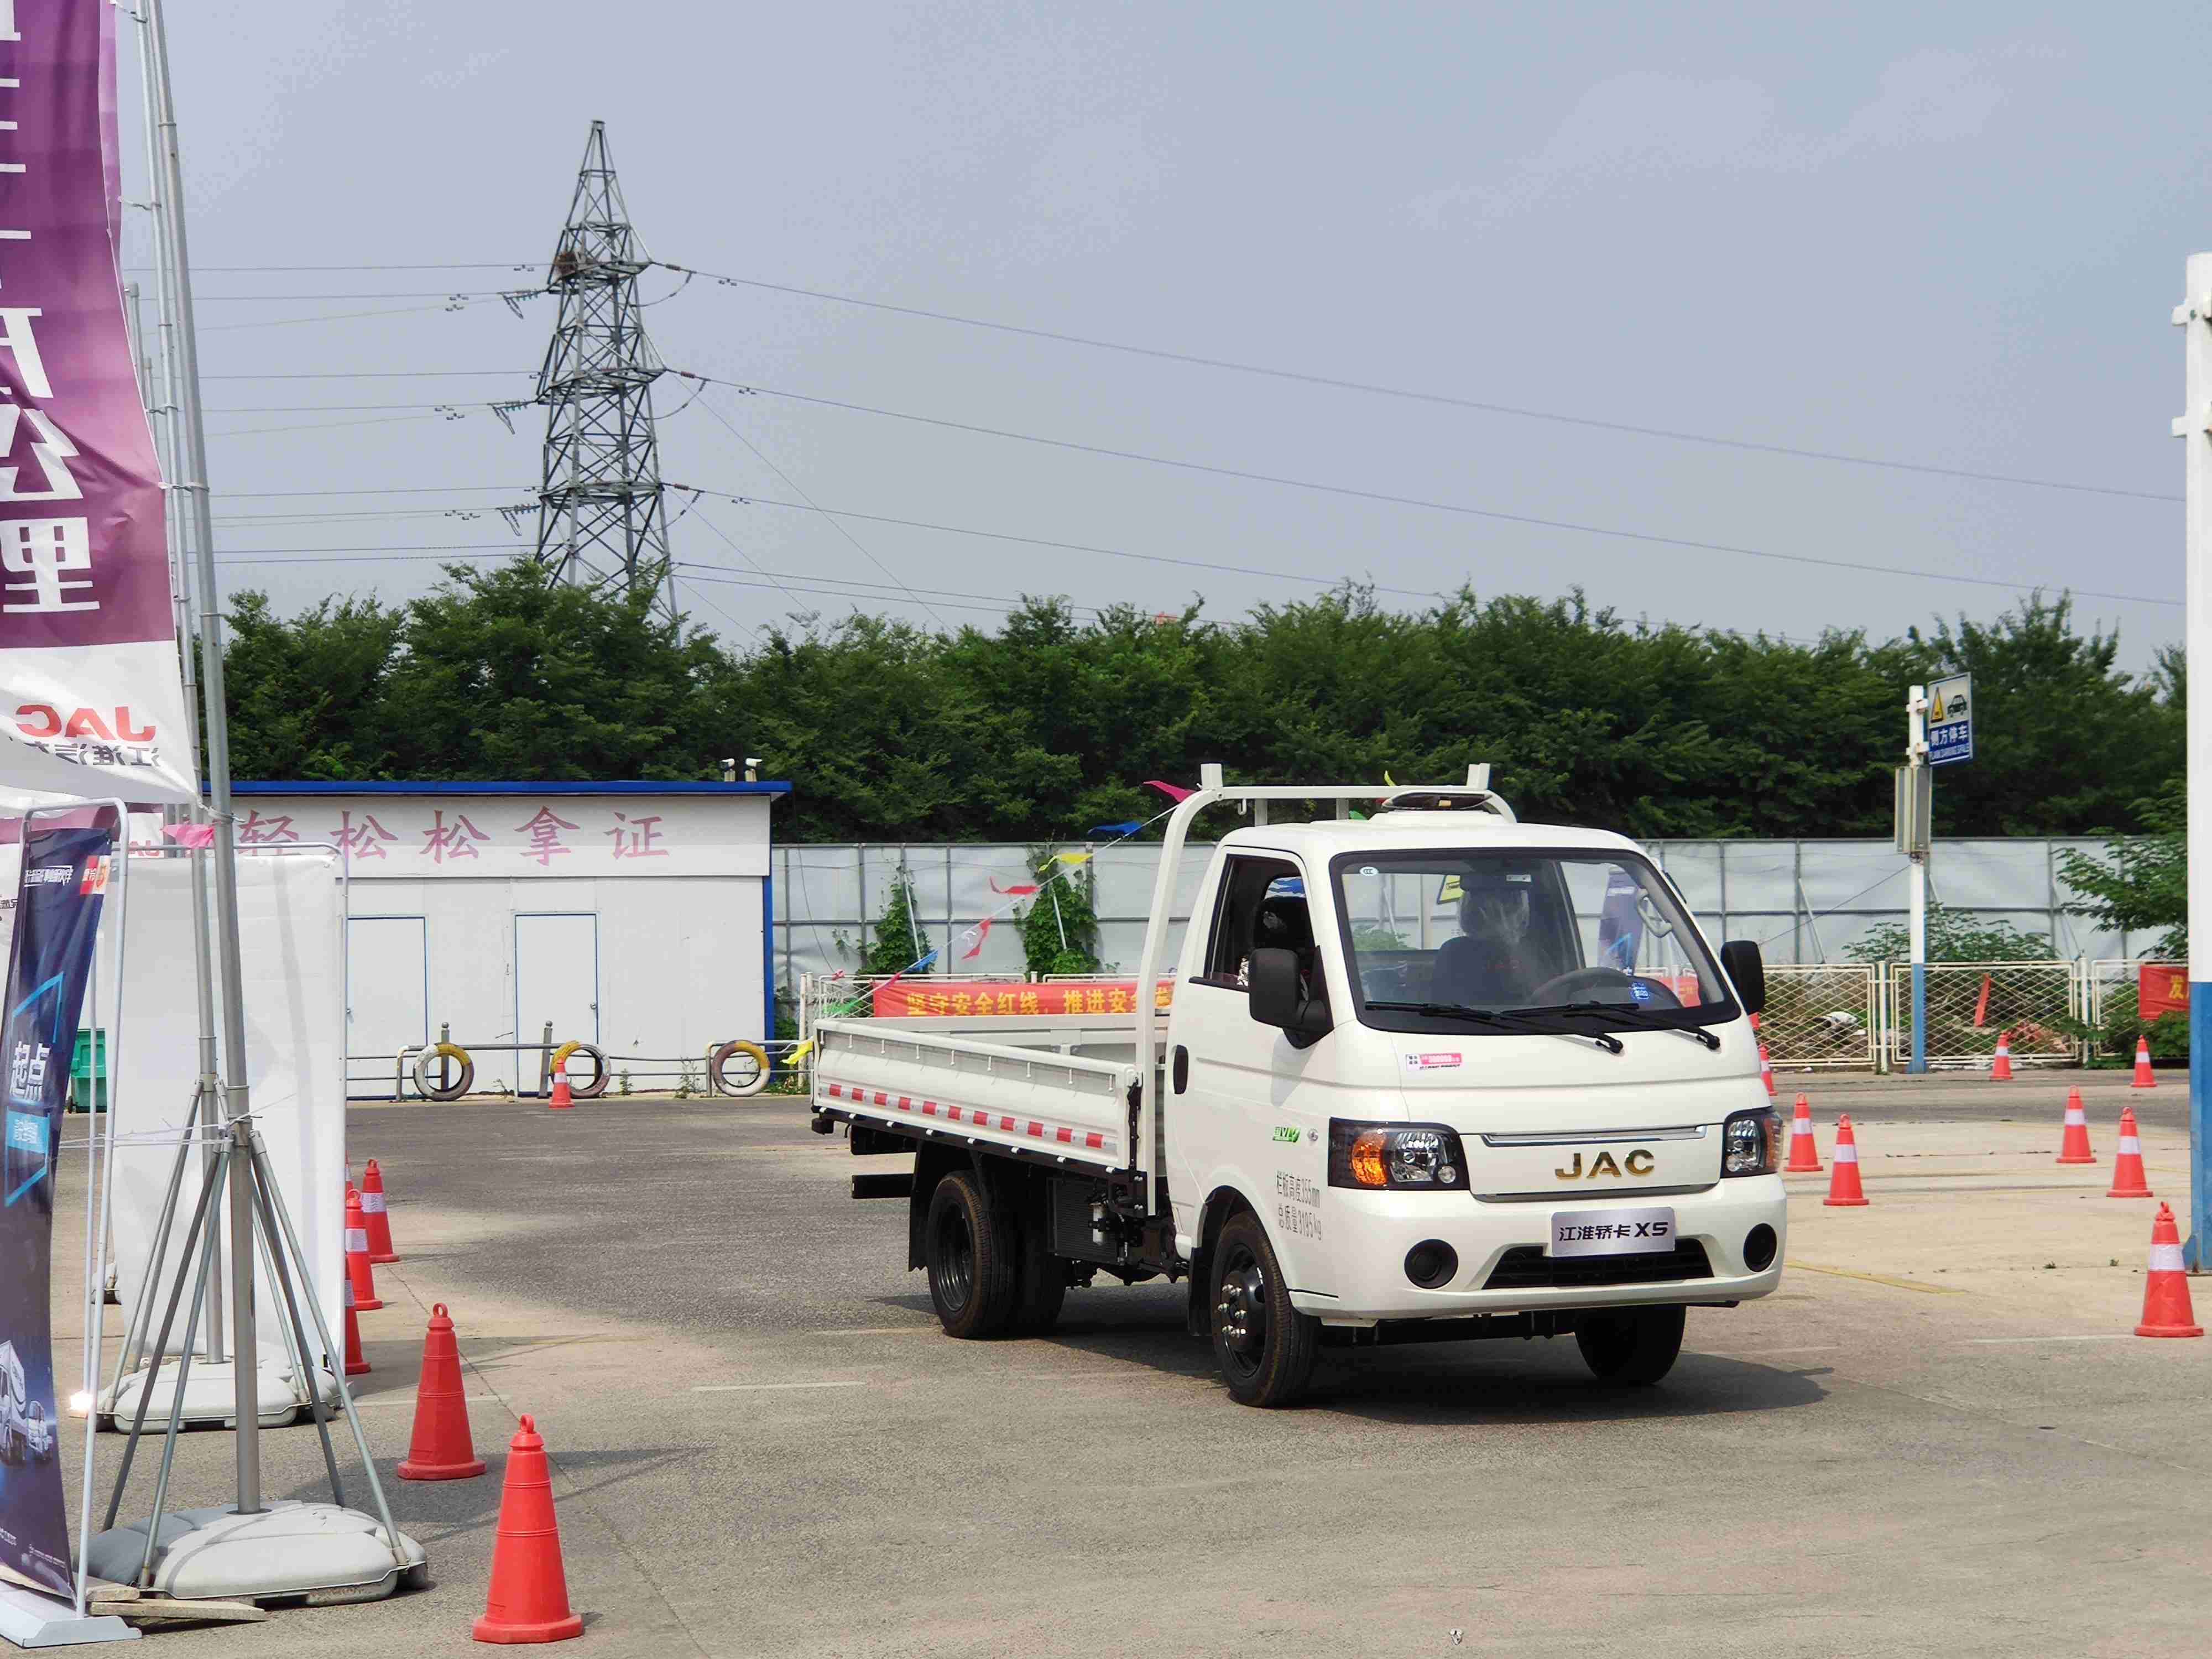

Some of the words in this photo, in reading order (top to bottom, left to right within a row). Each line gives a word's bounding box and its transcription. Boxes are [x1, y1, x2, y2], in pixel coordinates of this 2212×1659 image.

[1554, 1149, 1655, 1180] JAC
[1558, 1224, 1631, 1241] 江淮轿卡
